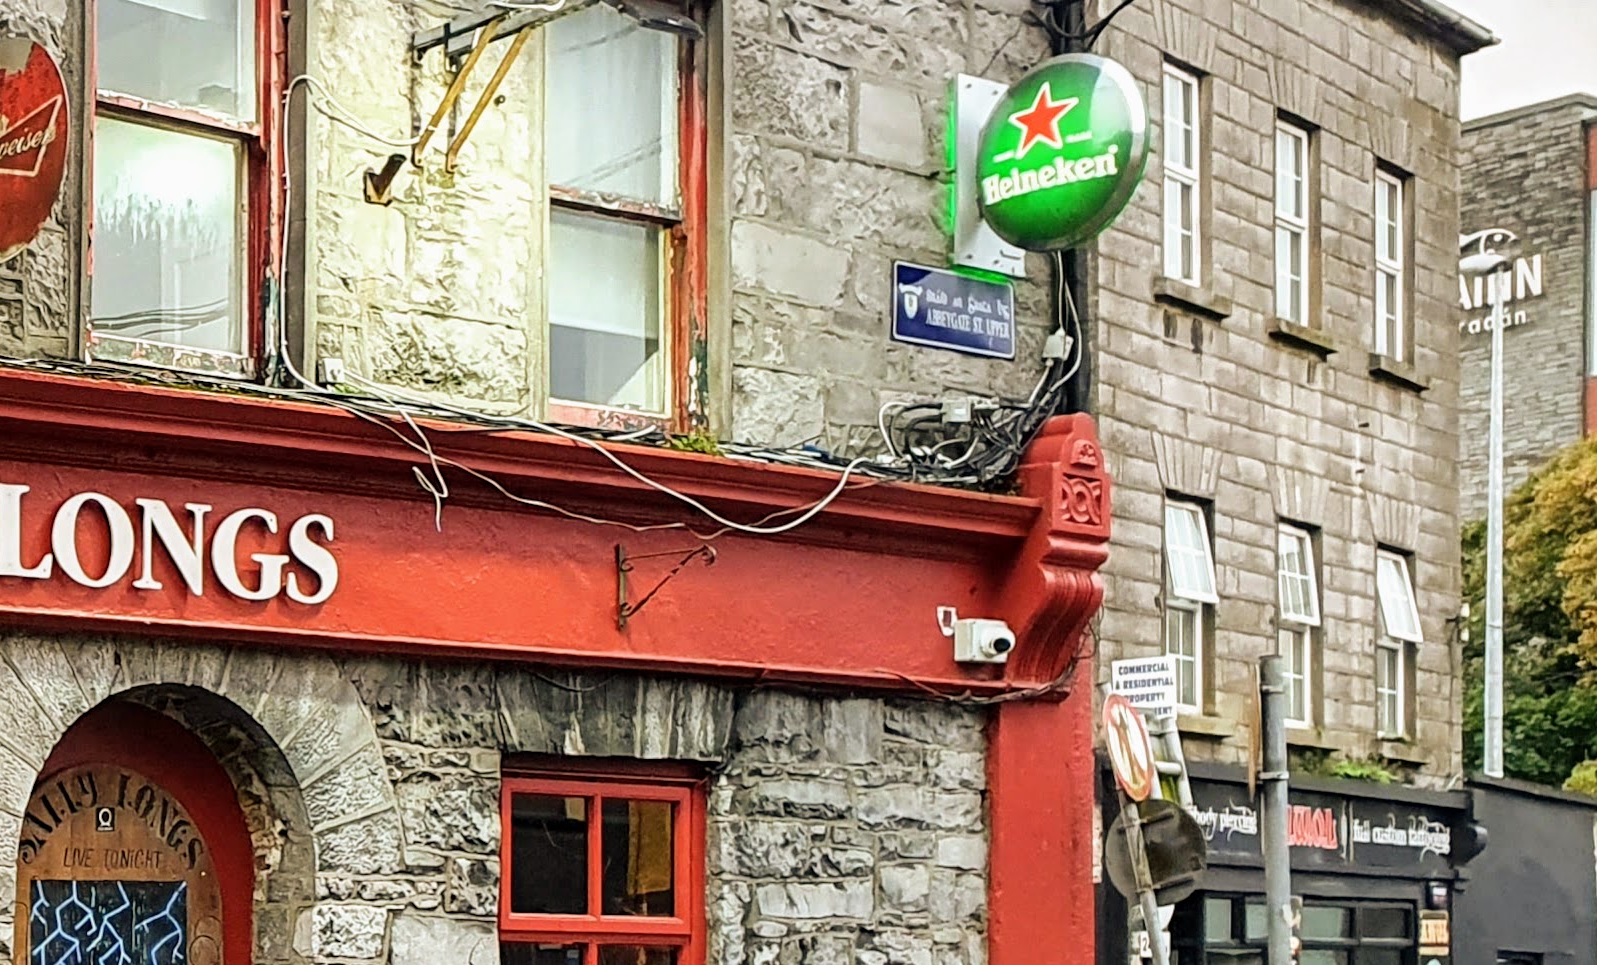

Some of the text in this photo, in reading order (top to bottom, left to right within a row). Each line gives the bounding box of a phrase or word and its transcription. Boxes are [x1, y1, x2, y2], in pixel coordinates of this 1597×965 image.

[982, 150, 1118, 205] Heineken
[925, 308, 971, 332] ABBEYGATE
[986, 319, 1010, 339] UPPER
[1118, 663, 1169, 676] COMMERCIAL
[1123, 677, 1174, 690] RESIDENTIAL
[19, 771, 203, 870] SALLY LONGS
[63, 847, 95, 868] LIVE
